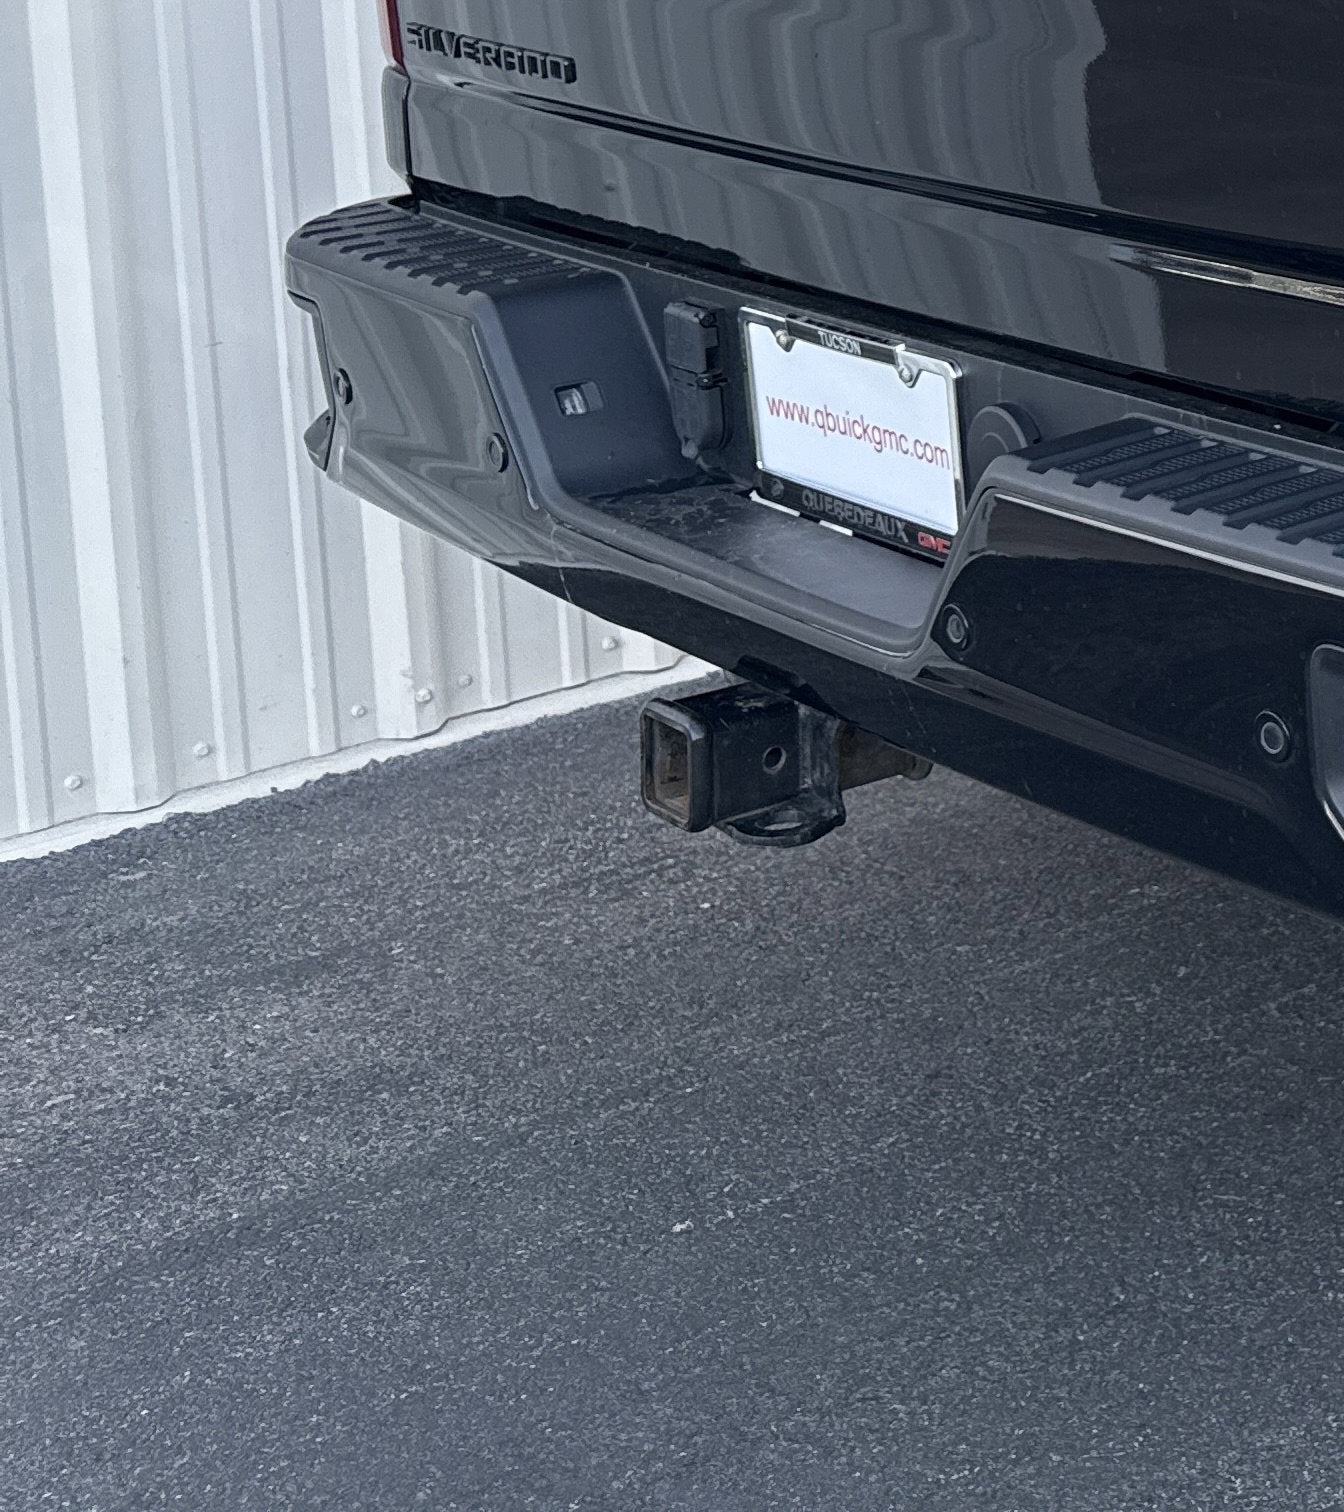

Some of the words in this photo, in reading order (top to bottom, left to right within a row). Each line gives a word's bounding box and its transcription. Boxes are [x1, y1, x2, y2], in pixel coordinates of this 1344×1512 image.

[406, 22, 577, 84] SILVERADO
[817, 330, 862, 356] TUCSON
[766, 396, 950, 470] www.qbuickgmc.com
[801, 489, 909, 544] QUEBEDEAUX
[917, 531, 952, 555] GMC
